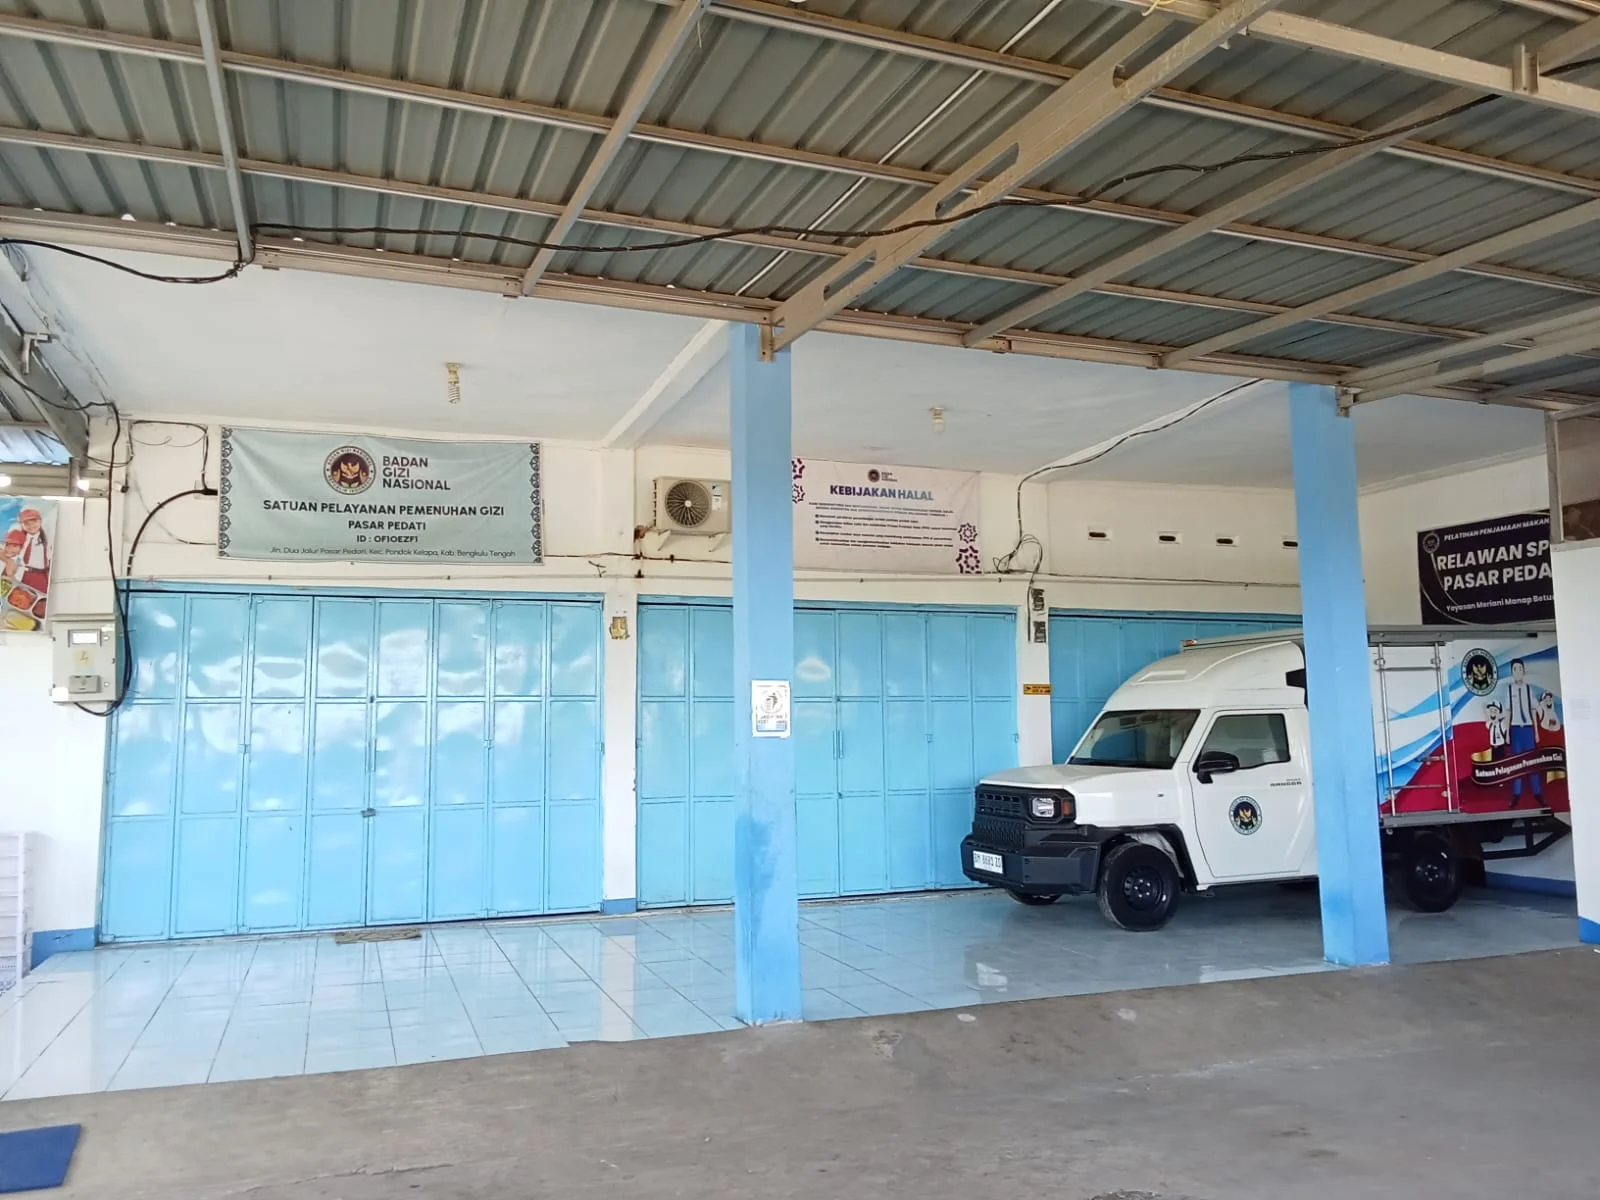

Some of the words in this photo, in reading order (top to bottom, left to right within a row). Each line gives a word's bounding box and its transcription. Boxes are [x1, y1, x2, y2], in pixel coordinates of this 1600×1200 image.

[382, 456, 428, 468] BADAN
[382, 467, 410, 478] GIZI
[382, 478, 451, 490] NASIONAL
[830, 485, 896, 498] KEBIJAKAN
[898, 489, 934, 501] HALAL
[263, 500, 318, 512] SATUAN
[321, 503, 396, 514] PELAYANAN
[399, 505, 477, 516] PEMENUHAN
[480, 506, 504, 516] GIZI
[348, 520, 384, 530] PASAR
[387, 521, 426, 530] PEDATI
[1444, 531, 1479, 541] PELATIHAN
[1480, 523, 1522, 535] PENJAMAAH
[1523, 518, 1549, 528] MAKAN
[357, 535, 367, 543] ID
[457, 549, 488, 557] Bengkulu
[489, 550, 516, 558] Tengah
[1436, 544, 1522, 570] RELAWAN
[1526, 540, 1549, 558] SP
[1443, 570, 1500, 591] PASAR
[1503, 563, 1553, 583] PEDA
[1446, 603, 1476, 613] Yayasan
